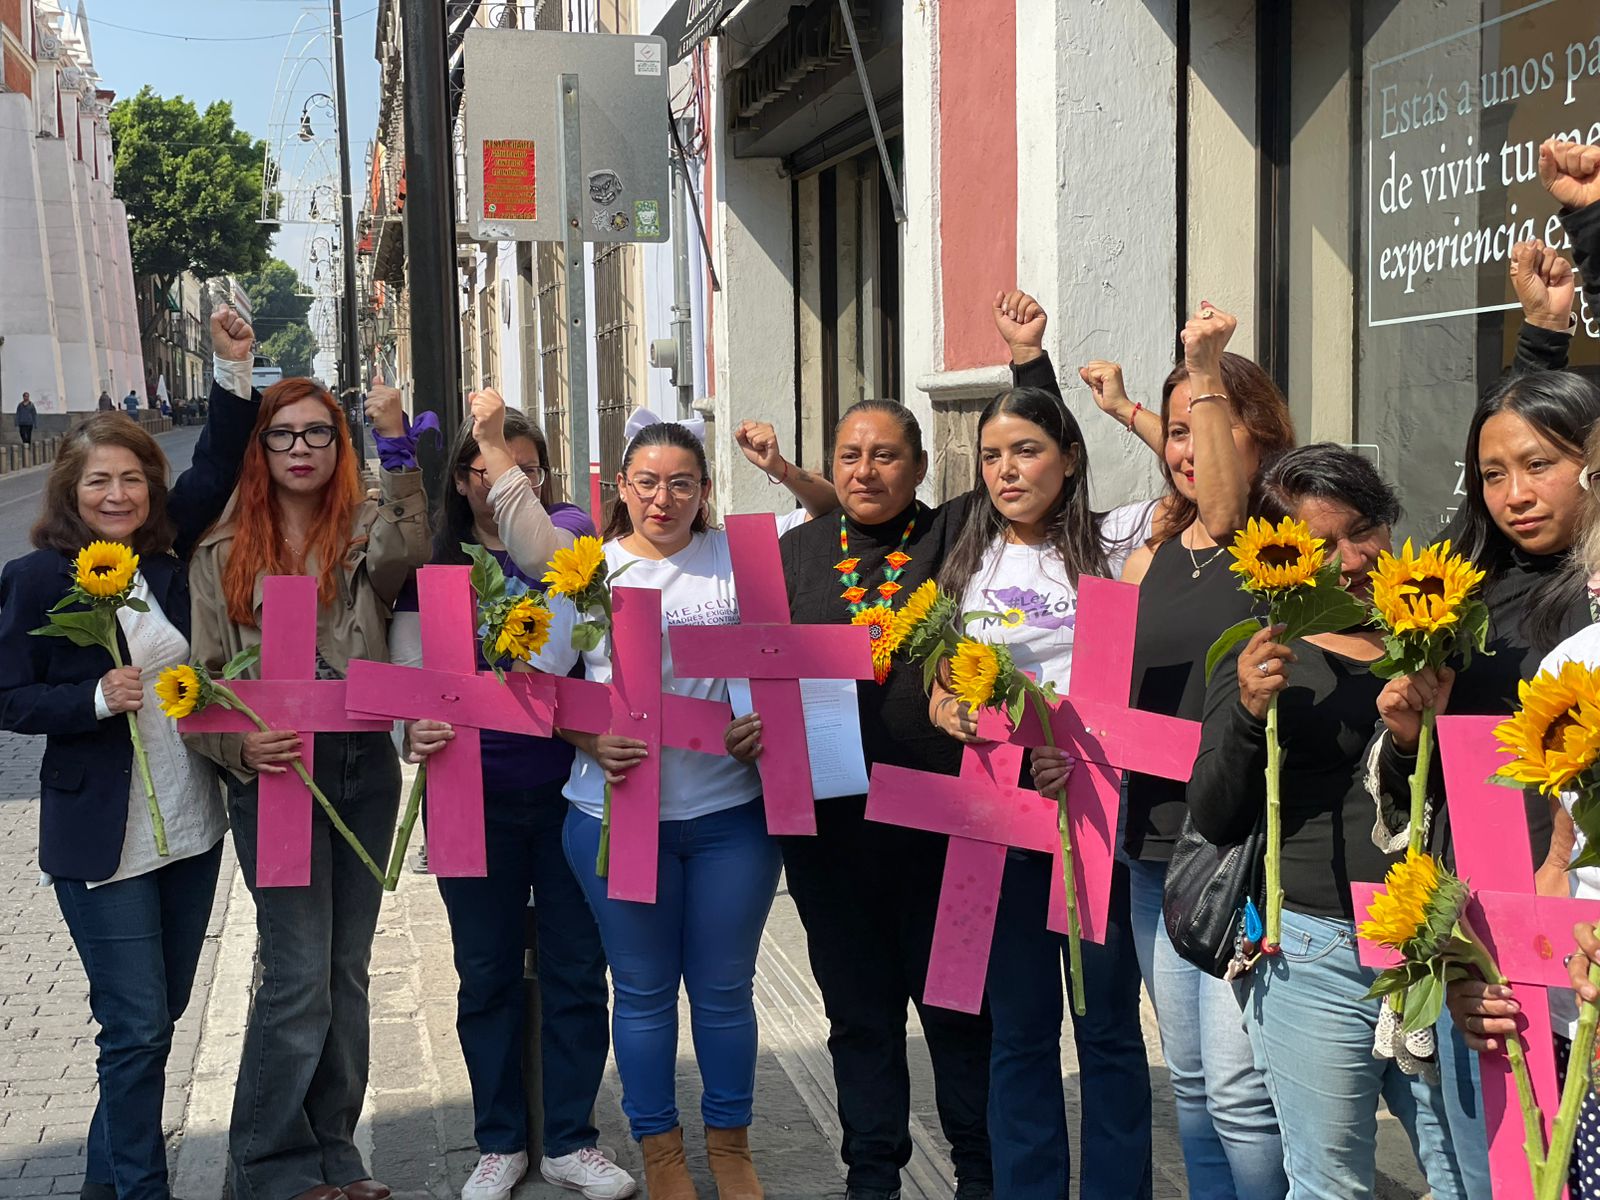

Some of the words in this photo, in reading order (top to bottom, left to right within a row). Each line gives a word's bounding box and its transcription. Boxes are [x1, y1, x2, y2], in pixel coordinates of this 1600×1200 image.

[1380, 74, 1449, 140] Estás
[1456, 79, 1473, 116] a
[1480, 51, 1555, 108] unos
[1379, 150, 1413, 215] de
[1421, 136, 1491, 205] vivir
[1500, 139, 1537, 187] tu
[1379, 204, 1536, 294] experiencia
[1008, 592, 1052, 609] #Ley
